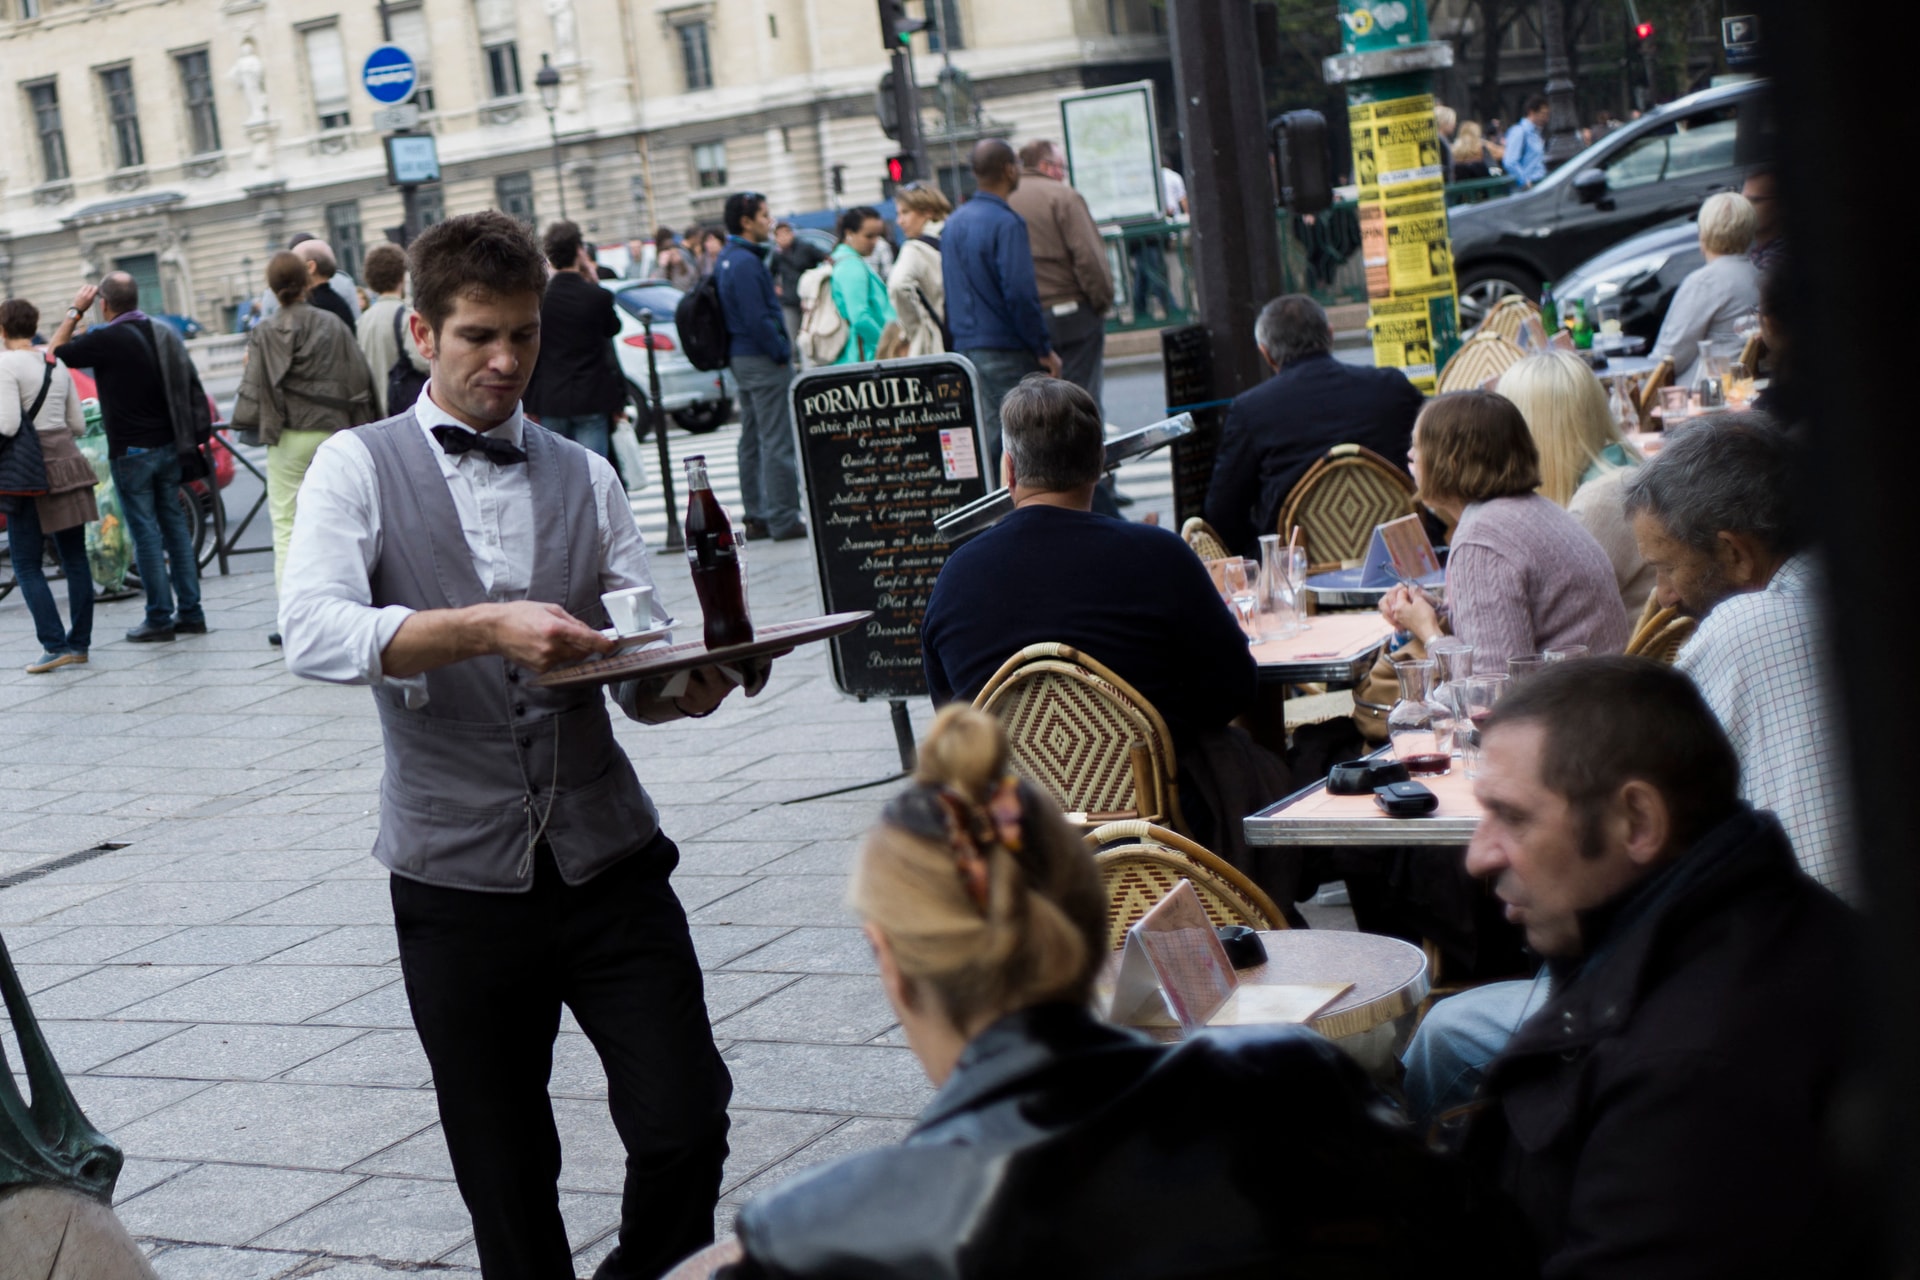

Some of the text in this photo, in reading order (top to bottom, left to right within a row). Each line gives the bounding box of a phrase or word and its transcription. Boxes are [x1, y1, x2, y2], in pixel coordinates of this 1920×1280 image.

[803, 377, 923, 416] FORMULE
[876, 417, 891, 428] ou
[841, 452, 876, 468] Quiche
[883, 452, 898, 464] du
[842, 473, 880, 486] Tomate
[875, 490, 888, 501] de
[838, 534, 885, 551] Saumon
[892, 537, 905, 546] au
[873, 575, 908, 592] Confit
[913, 575, 924, 586] de
[876, 593, 926, 609] Plat du
[866, 620, 917, 638] Desserts
